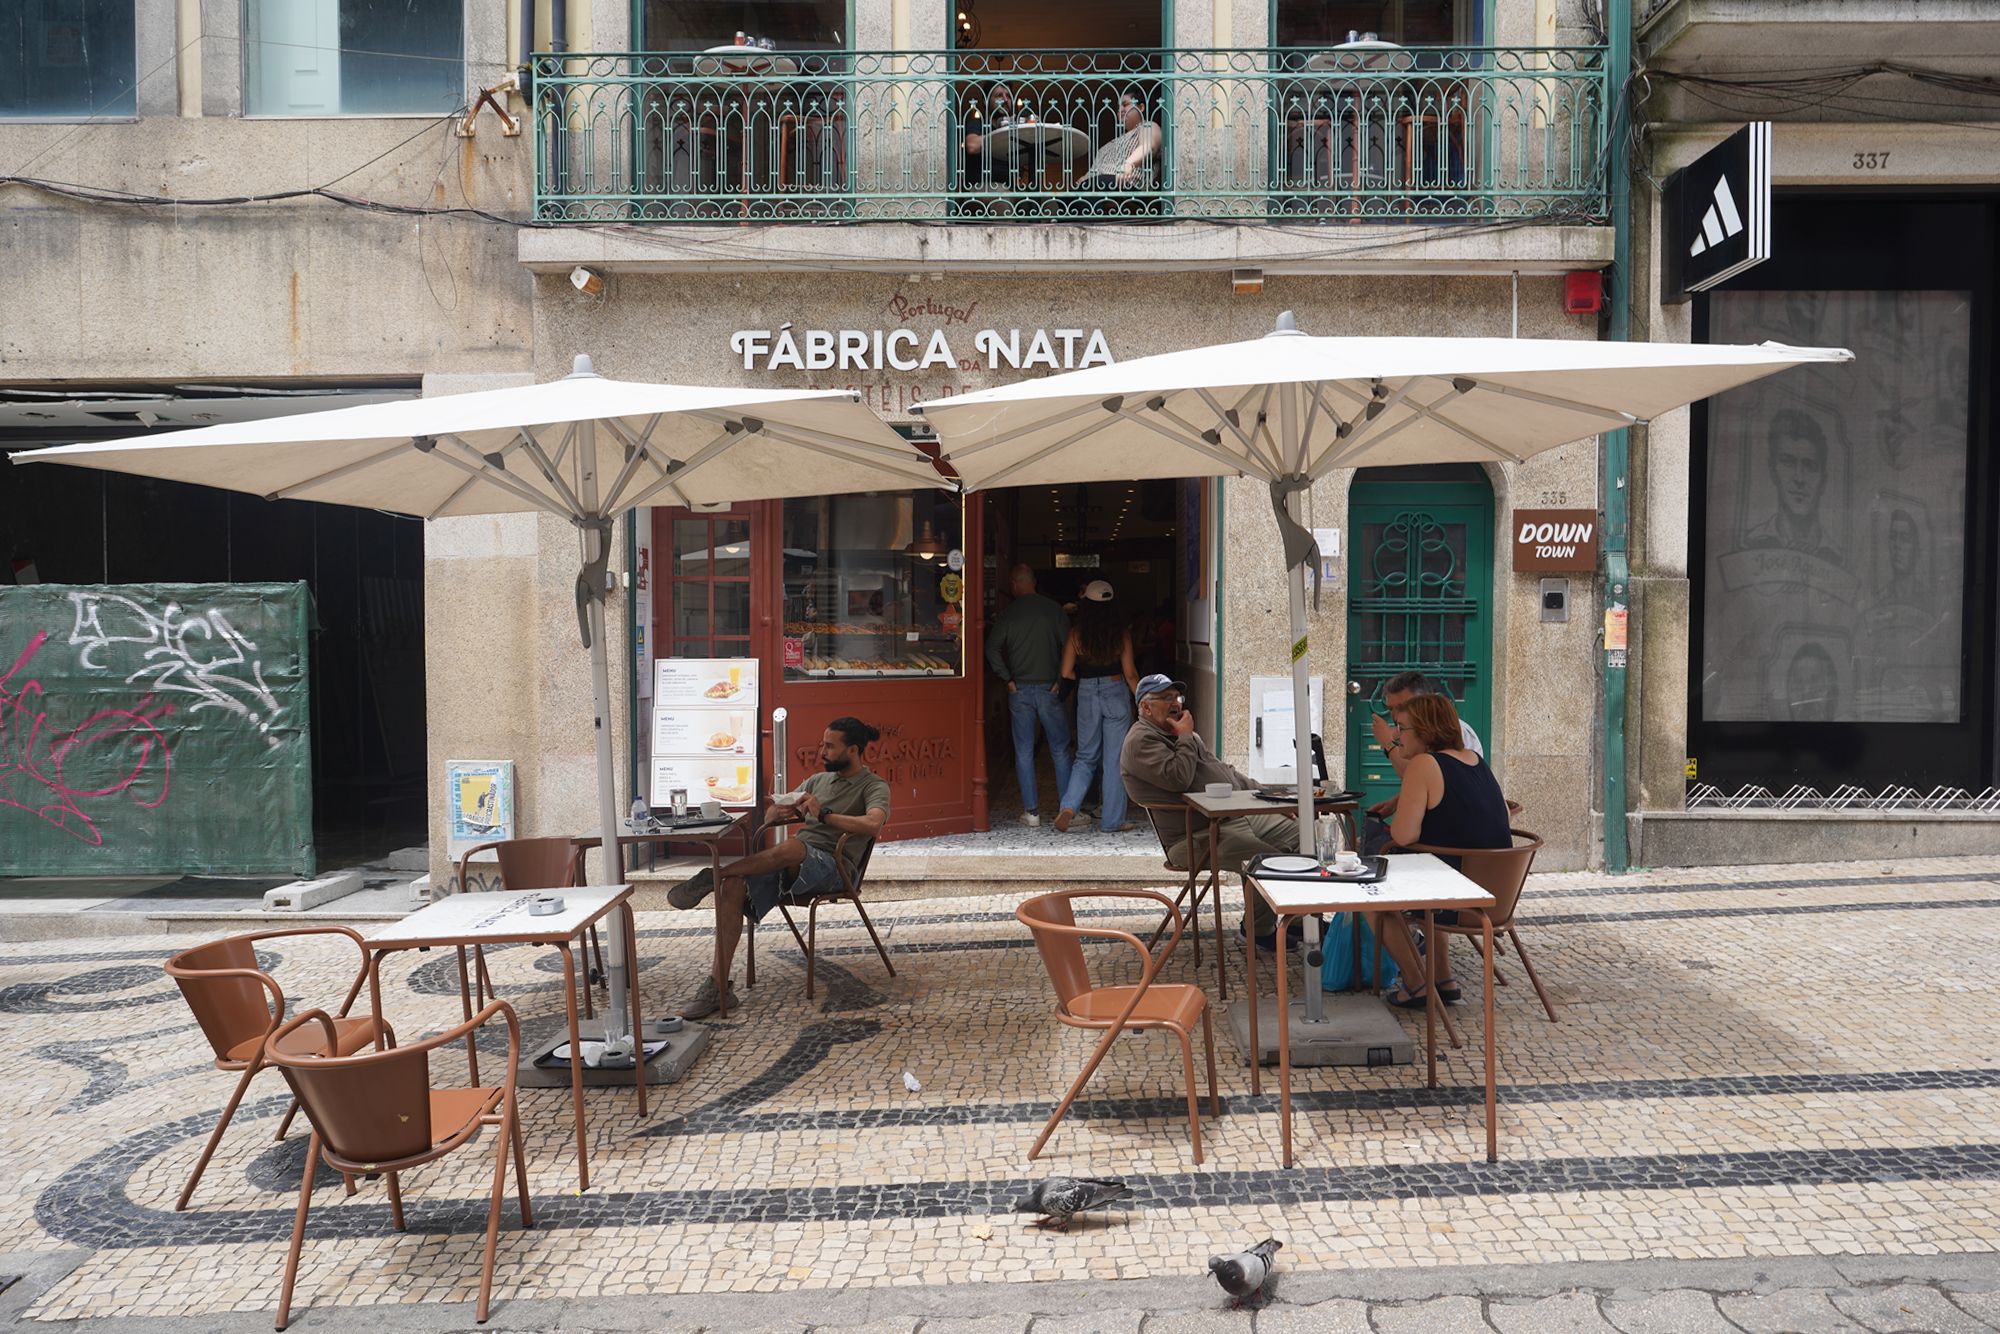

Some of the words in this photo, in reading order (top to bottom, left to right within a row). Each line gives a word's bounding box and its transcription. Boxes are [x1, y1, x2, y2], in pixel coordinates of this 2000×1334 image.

[1852, 152, 1891, 170] 337
[889, 293, 978, 326] Portugal
[730, 322, 958, 371] FÁBRICA
[958, 360, 981, 372] DA
[975, 328, 1115, 370] NATA
[1541, 491, 1567, 505] 335
[1518, 522, 1593, 544] DOWN
[1535, 545, 1576, 559] TOWN
